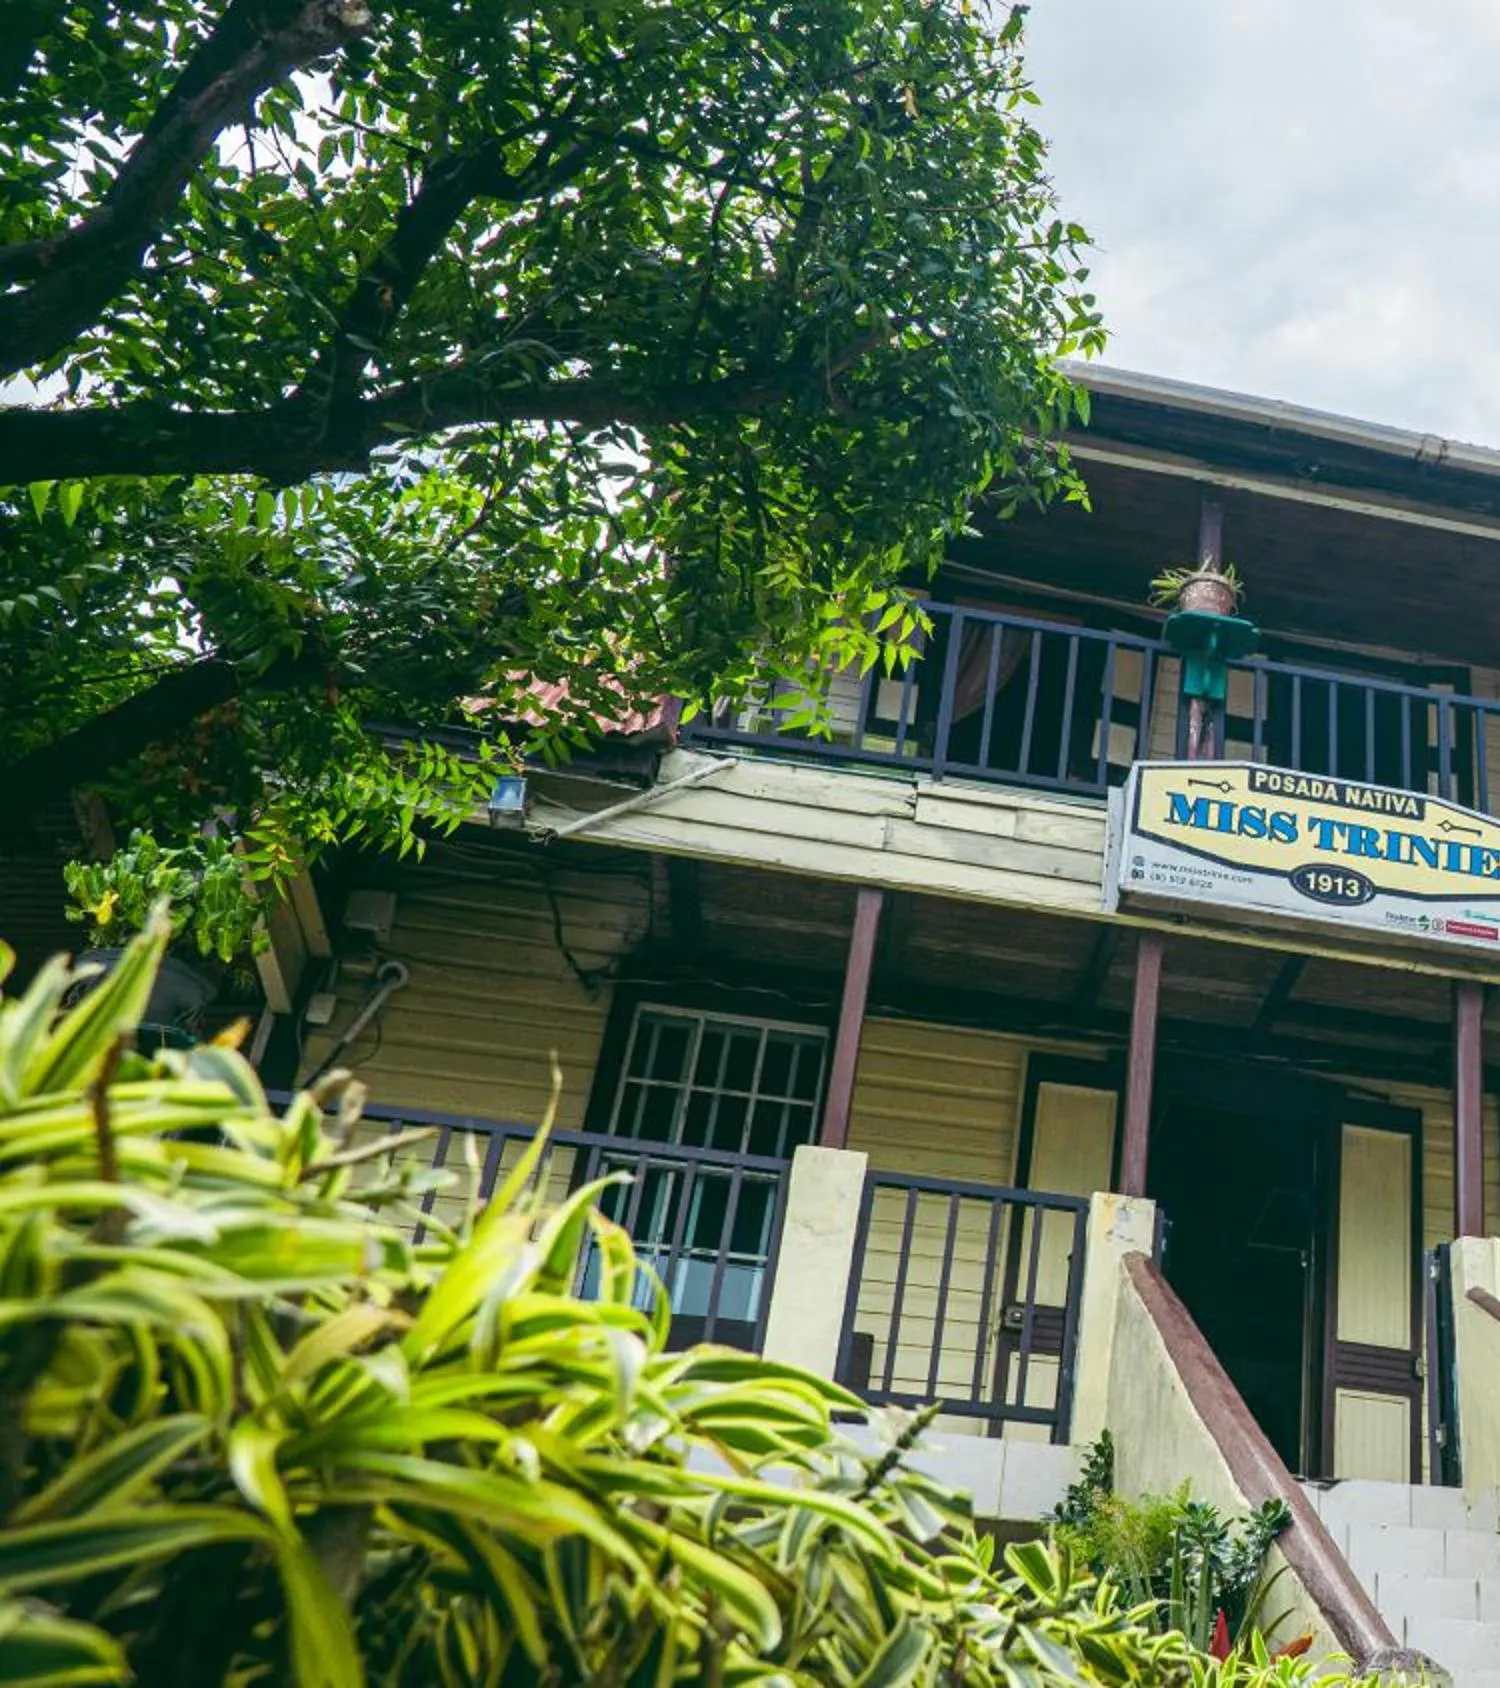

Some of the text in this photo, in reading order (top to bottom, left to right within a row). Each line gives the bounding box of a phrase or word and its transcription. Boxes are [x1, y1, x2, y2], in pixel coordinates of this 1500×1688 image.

[1254, 771, 1420, 817] POSADA NATIVA
[1163, 791, 1500, 881] MISS TRINIE
[1305, 872, 1361, 897] 1913
